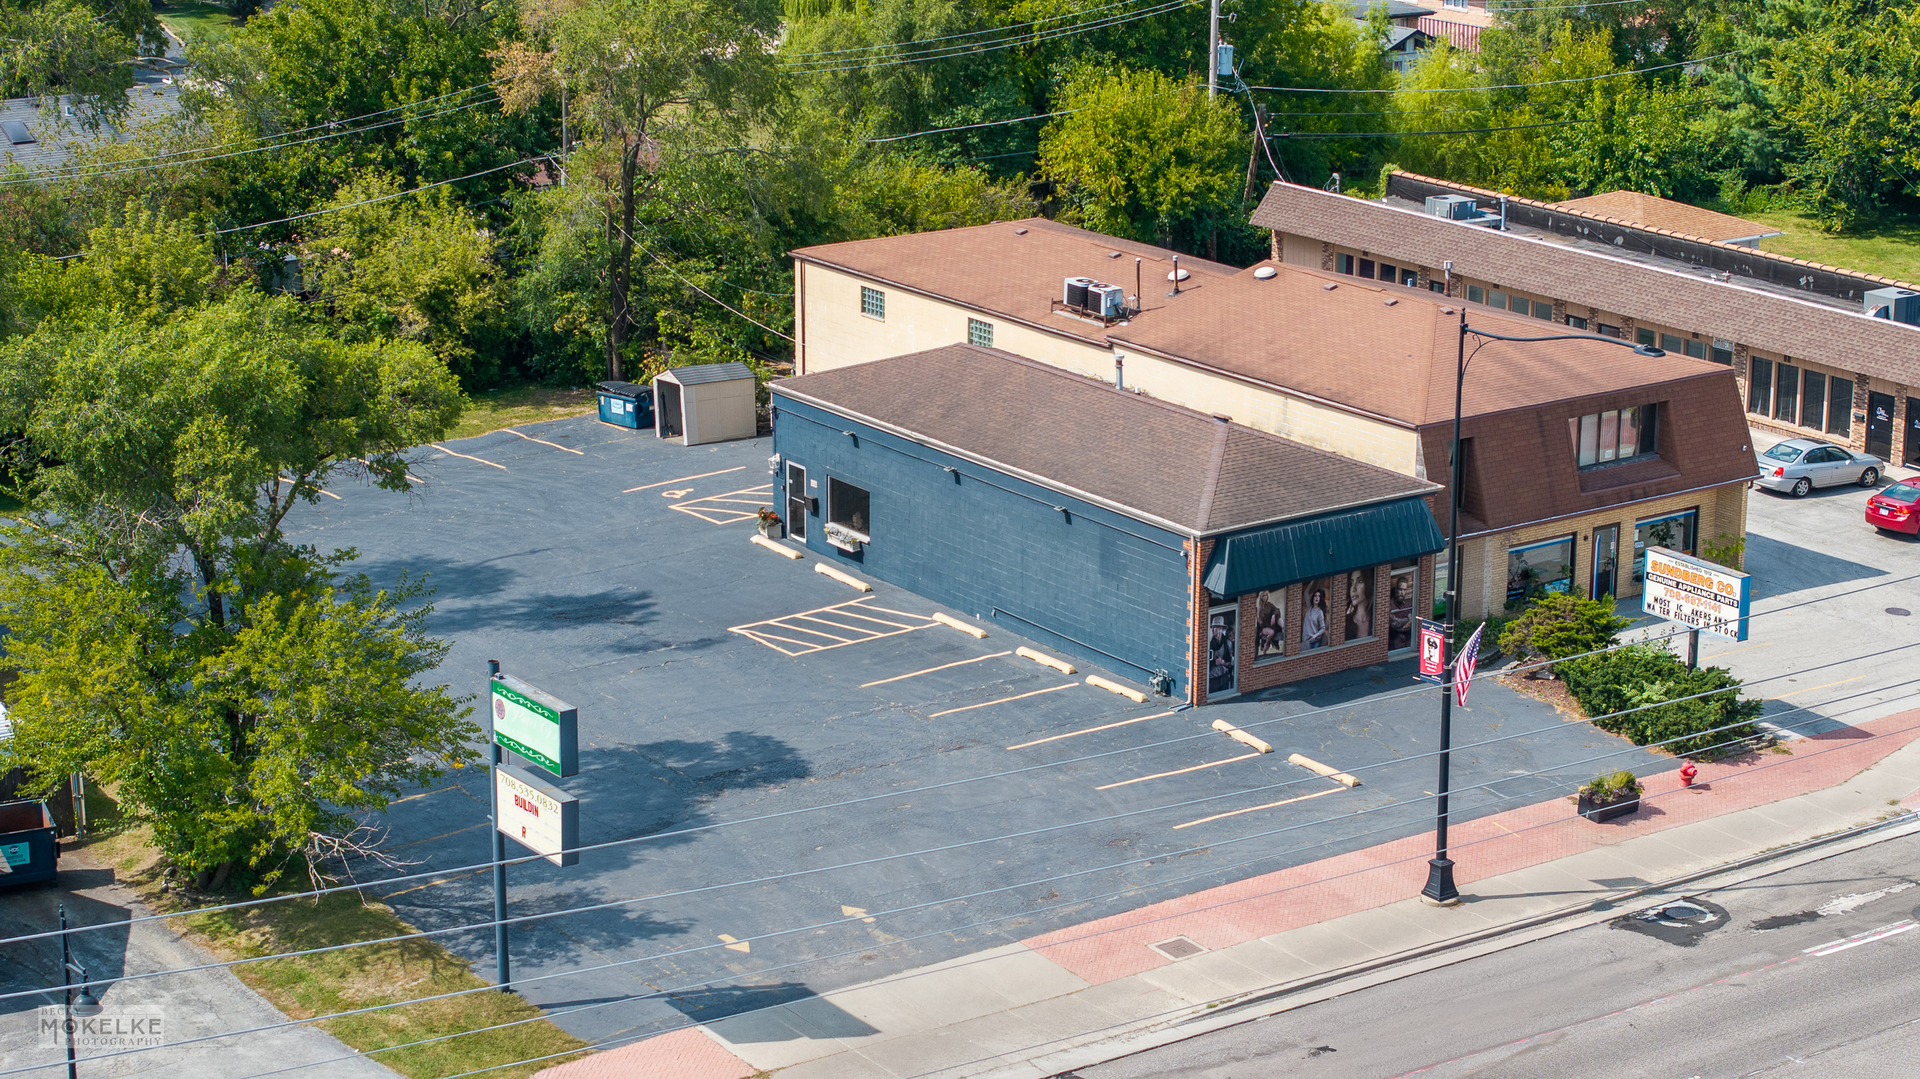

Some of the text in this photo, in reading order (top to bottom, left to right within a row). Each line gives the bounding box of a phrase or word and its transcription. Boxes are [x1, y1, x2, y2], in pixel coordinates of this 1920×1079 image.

[1651, 560, 1714, 589] SUNDBERG
[1675, 560, 1702, 573] ESTABLISHED
[1648, 573, 1738, 607] GENUINE APPLIANCE PARTS
[1653, 596, 1670, 608] MOST
[1676, 603, 1683, 612] IC
[1691, 608, 1712, 621] AKERS
[1674, 611, 1700, 626] FILTERS
[500, 773, 559, 814] 708.535.0832
[514, 794, 539, 818] BUILDIN
[521, 825, 527, 838] R
